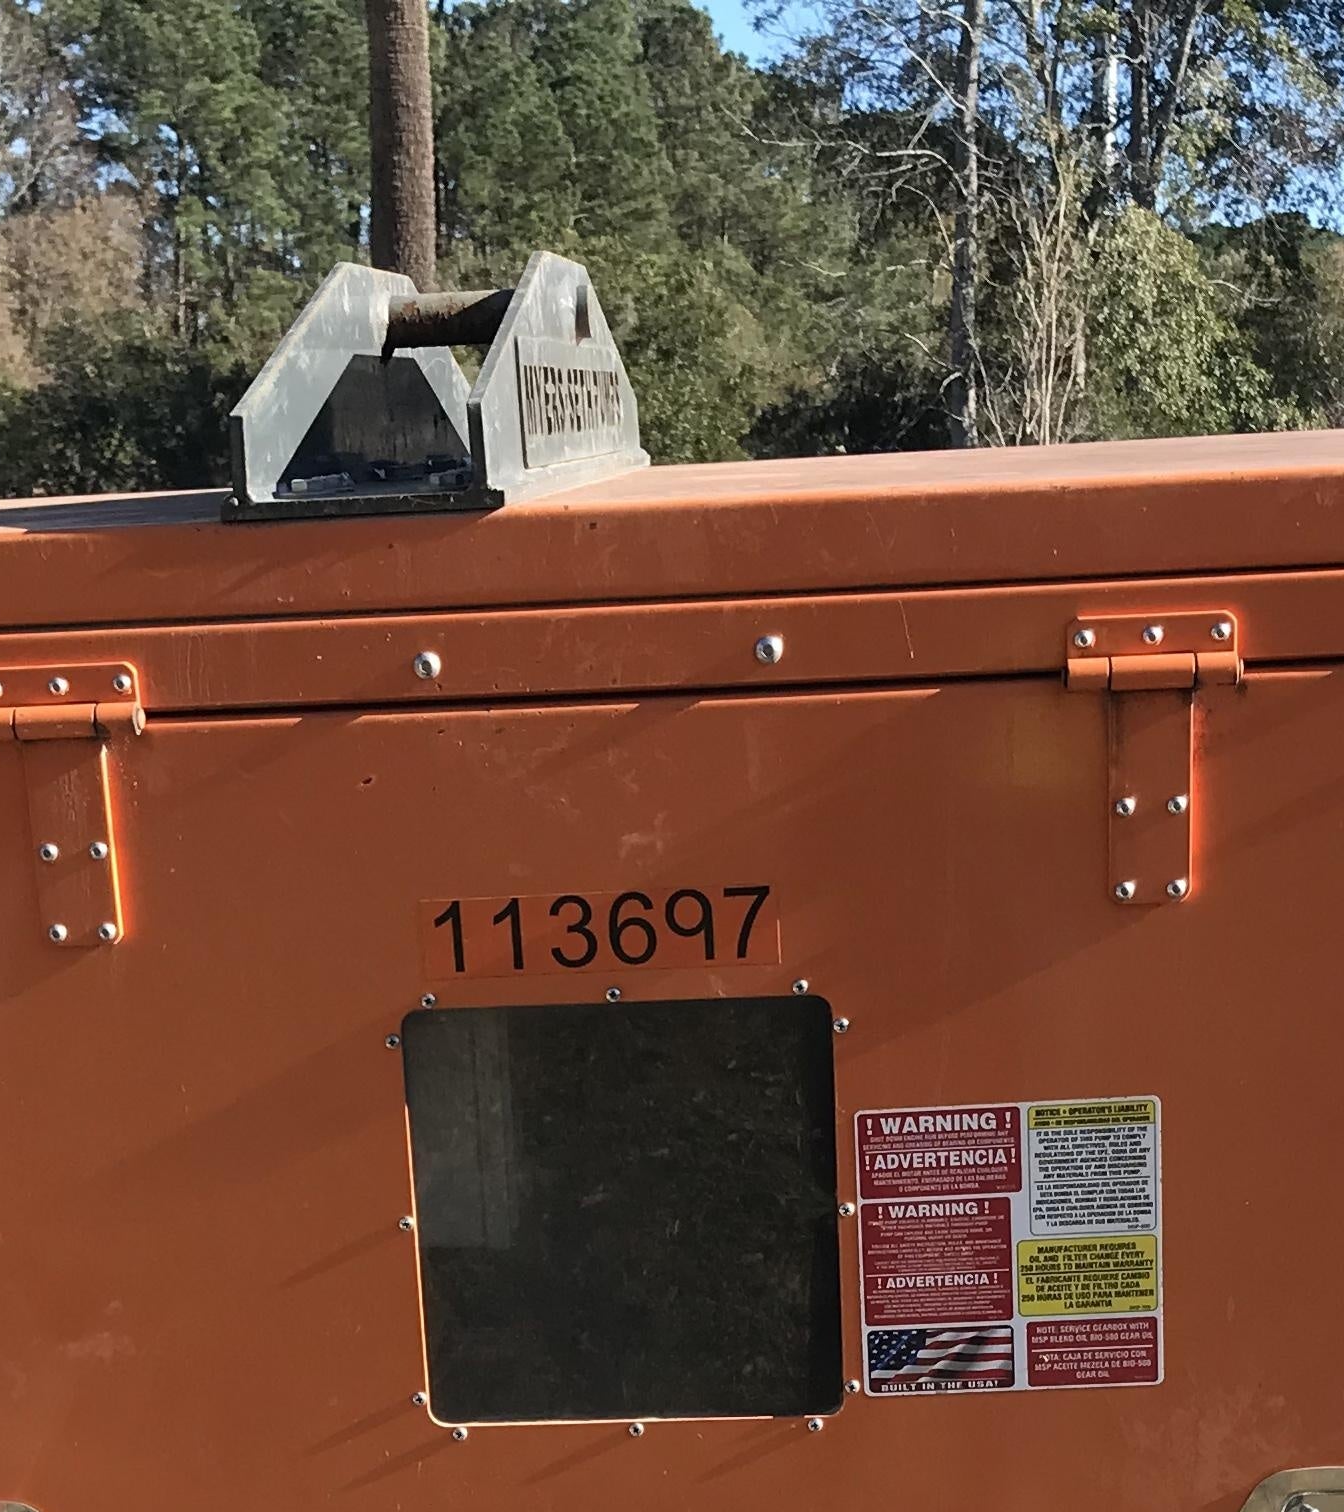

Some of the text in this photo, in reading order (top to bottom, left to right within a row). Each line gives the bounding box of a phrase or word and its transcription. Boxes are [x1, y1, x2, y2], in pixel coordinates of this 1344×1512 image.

[434, 884, 771, 973] 113697
[879, 1112, 996, 1134] WARNING
[873, 1149, 1007, 1169] ADVERTENCIA
[888, 1202, 978, 1218] WARNING
[1029, 1250, 1144, 1263] OIL AND FILTER CHANGE EVERY
[1035, 1263, 1061, 1271] HOURS
[1074, 1261, 1110, 1269] MAINTAIN
[1112, 1259, 1153, 1267] WARRANTY
[885, 1273, 989, 1288] ADVERTENCIA
[1060, 1324, 1090, 1332] SERVICE
[1092, 1323, 1127, 1331] GEARBOX
[881, 1384, 916, 1392] BUILT
[968, 1380, 998, 1388] USA!
